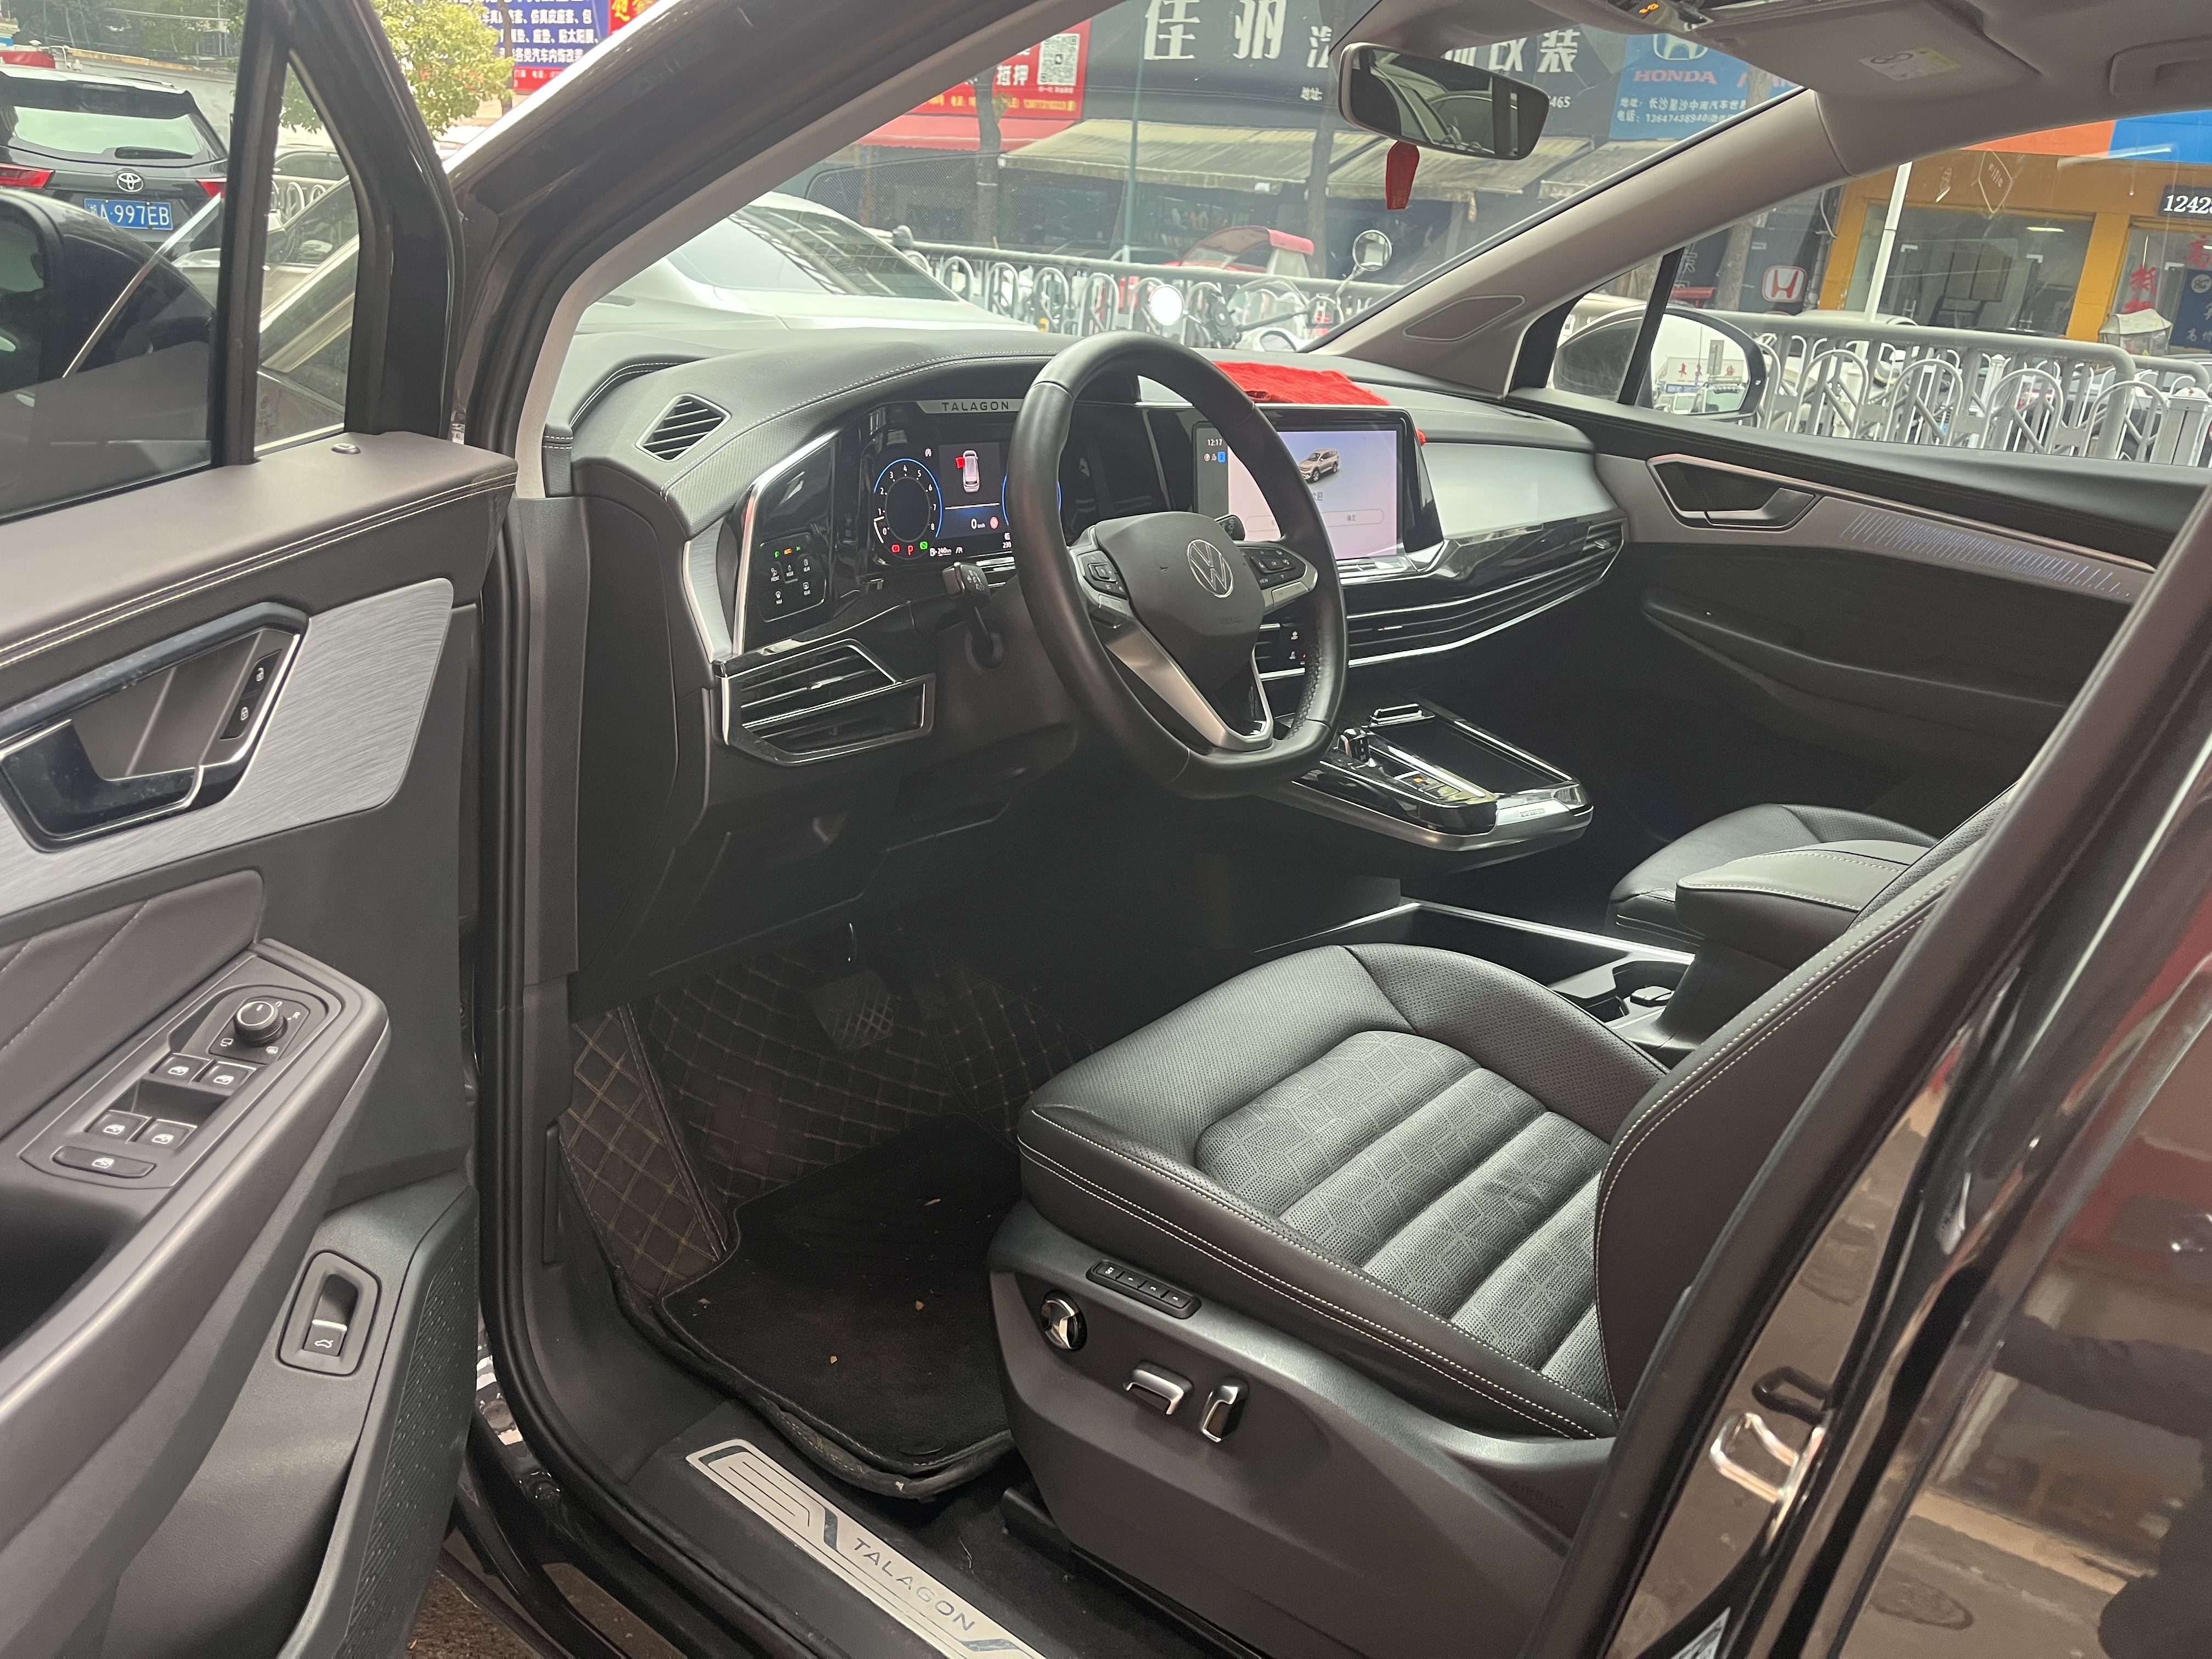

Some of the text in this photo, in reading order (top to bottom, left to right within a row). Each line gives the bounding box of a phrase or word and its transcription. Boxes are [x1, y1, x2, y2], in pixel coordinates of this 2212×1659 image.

[1633, 70, 1718, 84] HONDA
[1549, 95, 1571, 108] 465
[2164, 194, 2212, 215] 1242
[941, 401, 1009, 411] TALAGON
[930, 523, 935, 531] 8
[970, 518, 977, 529] 0
[854, 1537, 976, 1631] TALAGON
